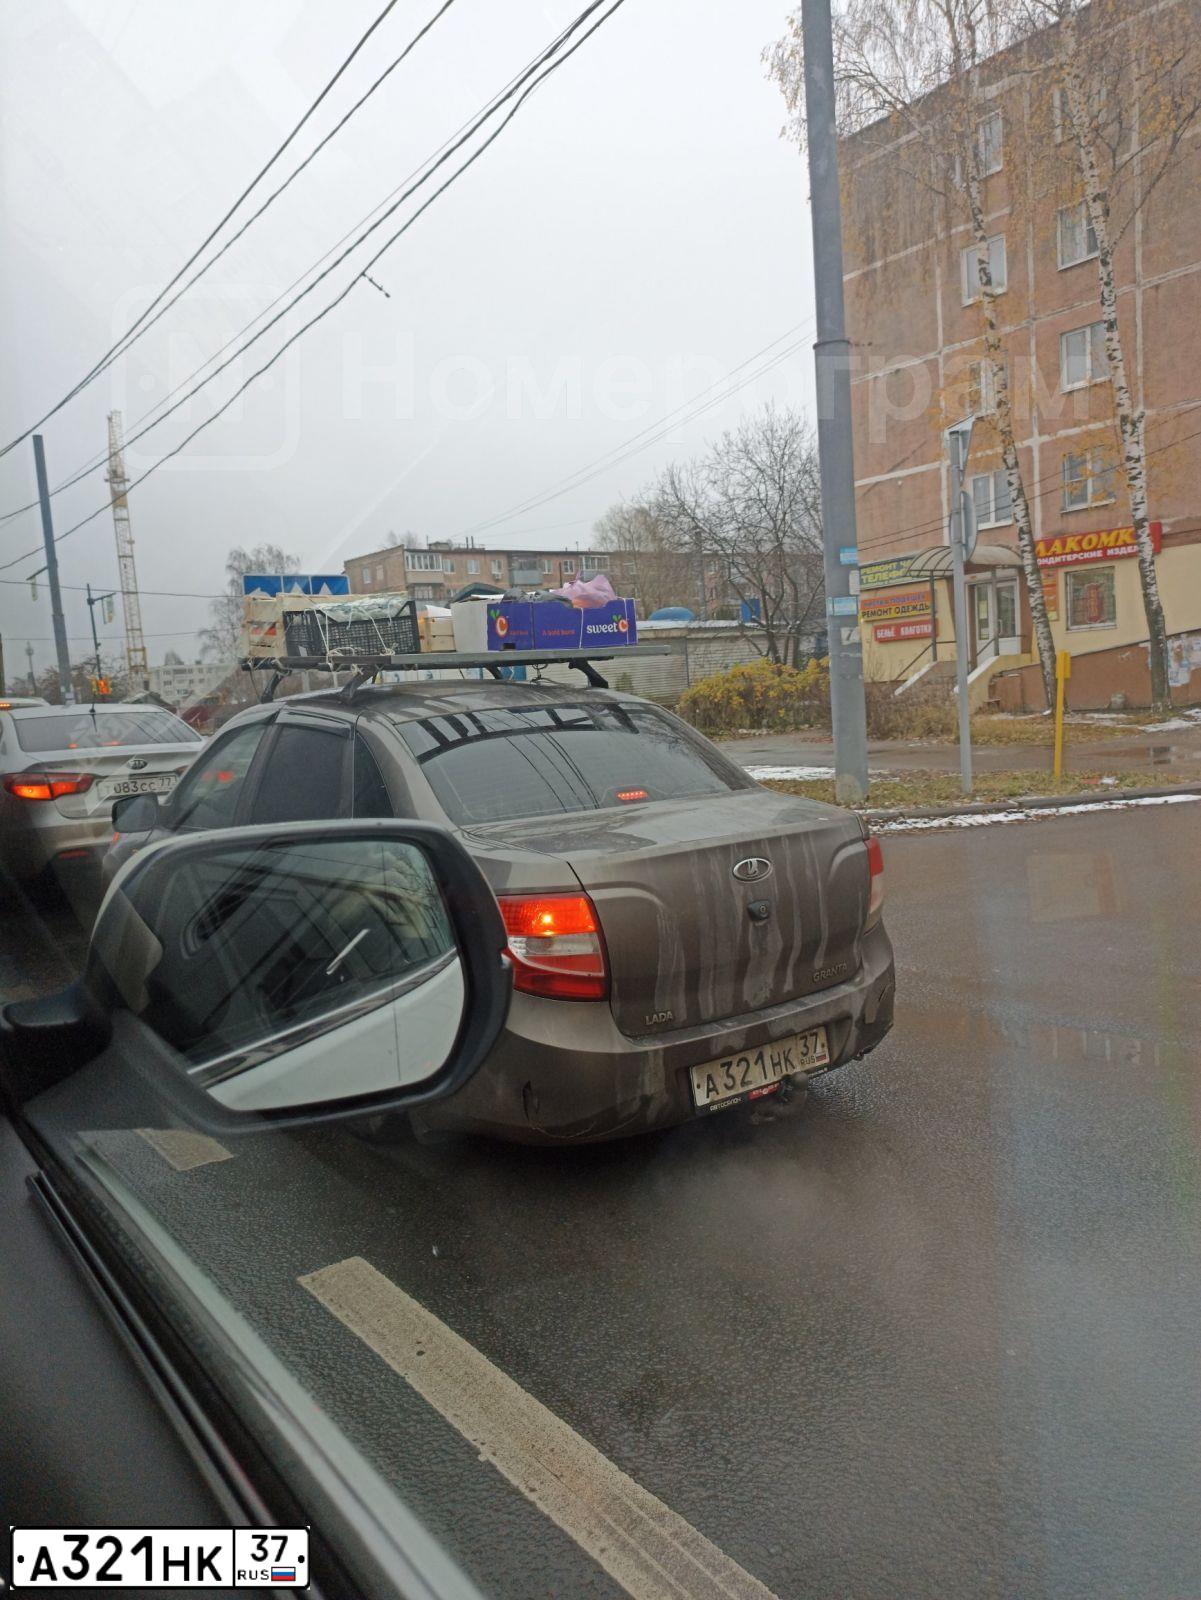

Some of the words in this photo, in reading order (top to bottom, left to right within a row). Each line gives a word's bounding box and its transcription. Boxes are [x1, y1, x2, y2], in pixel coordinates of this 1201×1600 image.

[1036, 529, 1137, 557] ЛАКОМК
[1037, 550, 1103, 565] ОНДИТЕРСКИЕ
[1107, 545, 1139, 556] ИЗДЕЛ
[862, 607, 893, 618] РЕМОНТ
[813, 962, 847, 982] GRANTA
[645, 1010, 673, 1025] LADA
[799, 1032, 818, 1057] 37
[801, 1056, 816, 1065] RUS
